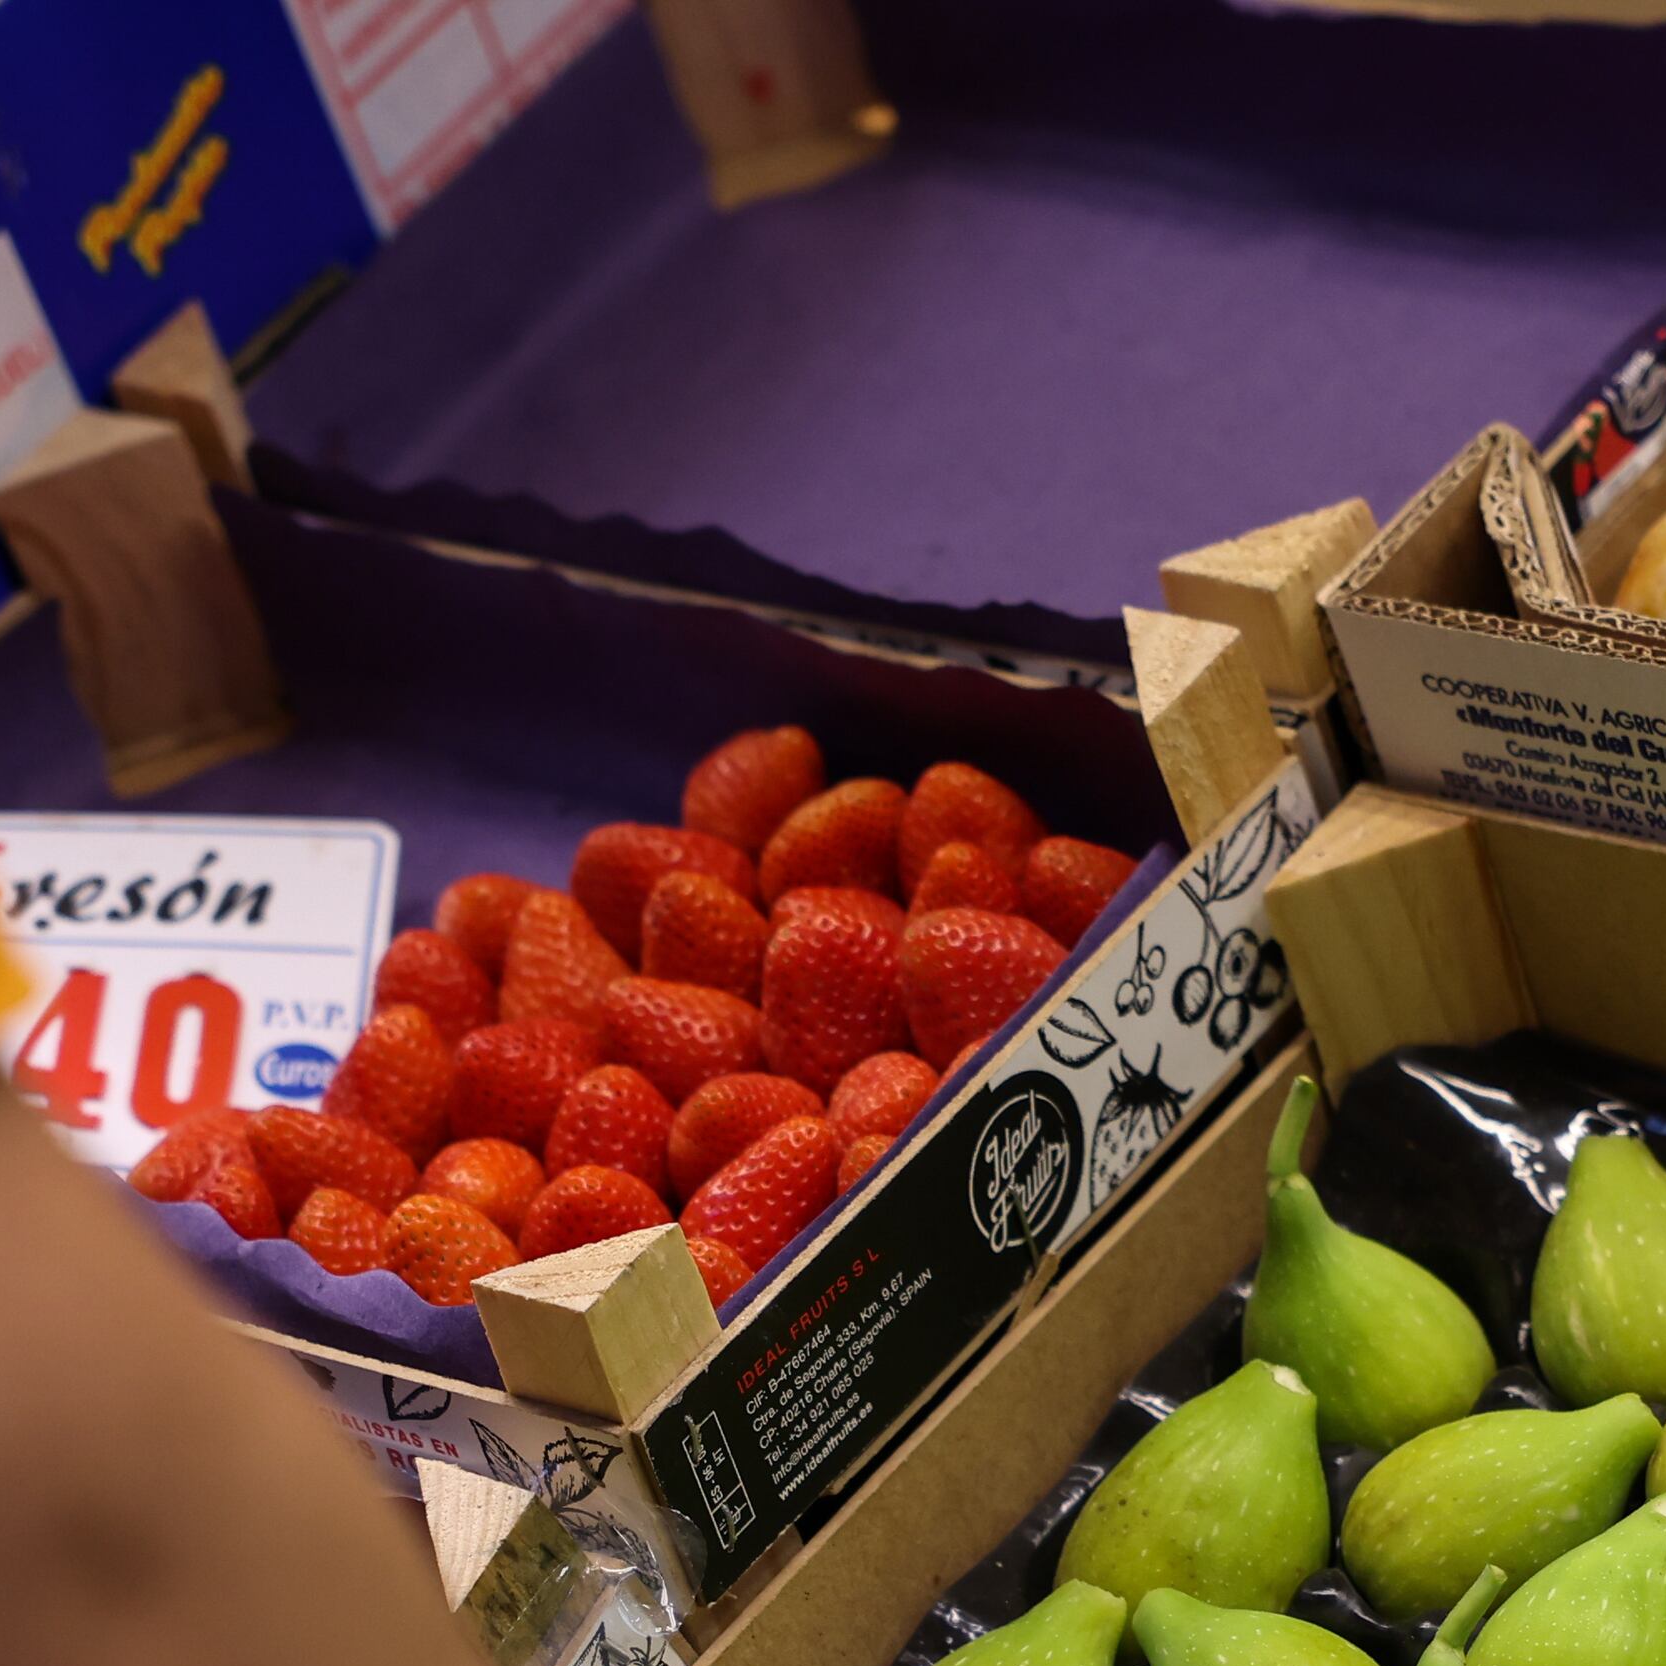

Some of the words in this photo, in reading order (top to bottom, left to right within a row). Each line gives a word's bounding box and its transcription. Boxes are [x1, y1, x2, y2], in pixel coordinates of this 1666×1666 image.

[1421, 673, 1570, 719] COOPERATIVA
[1572, 701, 1595, 724] V.
[1591, 730, 1635, 758] del
[1646, 767, 1661, 786] 2
[263, 1001, 349, 1030] P.V.P.
[985, 1089, 1042, 1200] Ideal
[735, 1342, 788, 1394] IDEAL
[790, 1274, 850, 1341] FRUITS
[745, 1390, 770, 1416] CIF:
[767, 1324, 832, 1394] B-47667464
[752, 1405, 779, 1433] Ctra.
[778, 1389, 794, 1407] de
[793, 1346, 836, 1391] Segovia
[835, 1321, 862, 1349] 333,
[859, 1301, 882, 1324] Km.
[881, 1271, 904, 1301] 9,67
[759, 1426, 780, 1450] CP:
[780, 1393, 814, 1429] 40216
[848, 1305, 900, 1359] (Segovia).
[898, 1267, 933, 1308] SPAIN
[430, 1437, 460, 1459] EN
[764, 1442, 788, 1468] Tel.:
[788, 1421, 810, 1443] +34
[809, 1398, 830, 1424] 921
[831, 1376, 853, 1401] 065
[852, 1351, 876, 1378] 025
[778, 1401, 875, 1502] www.idealfruits.es
[711, 1447, 727, 1468] HT
